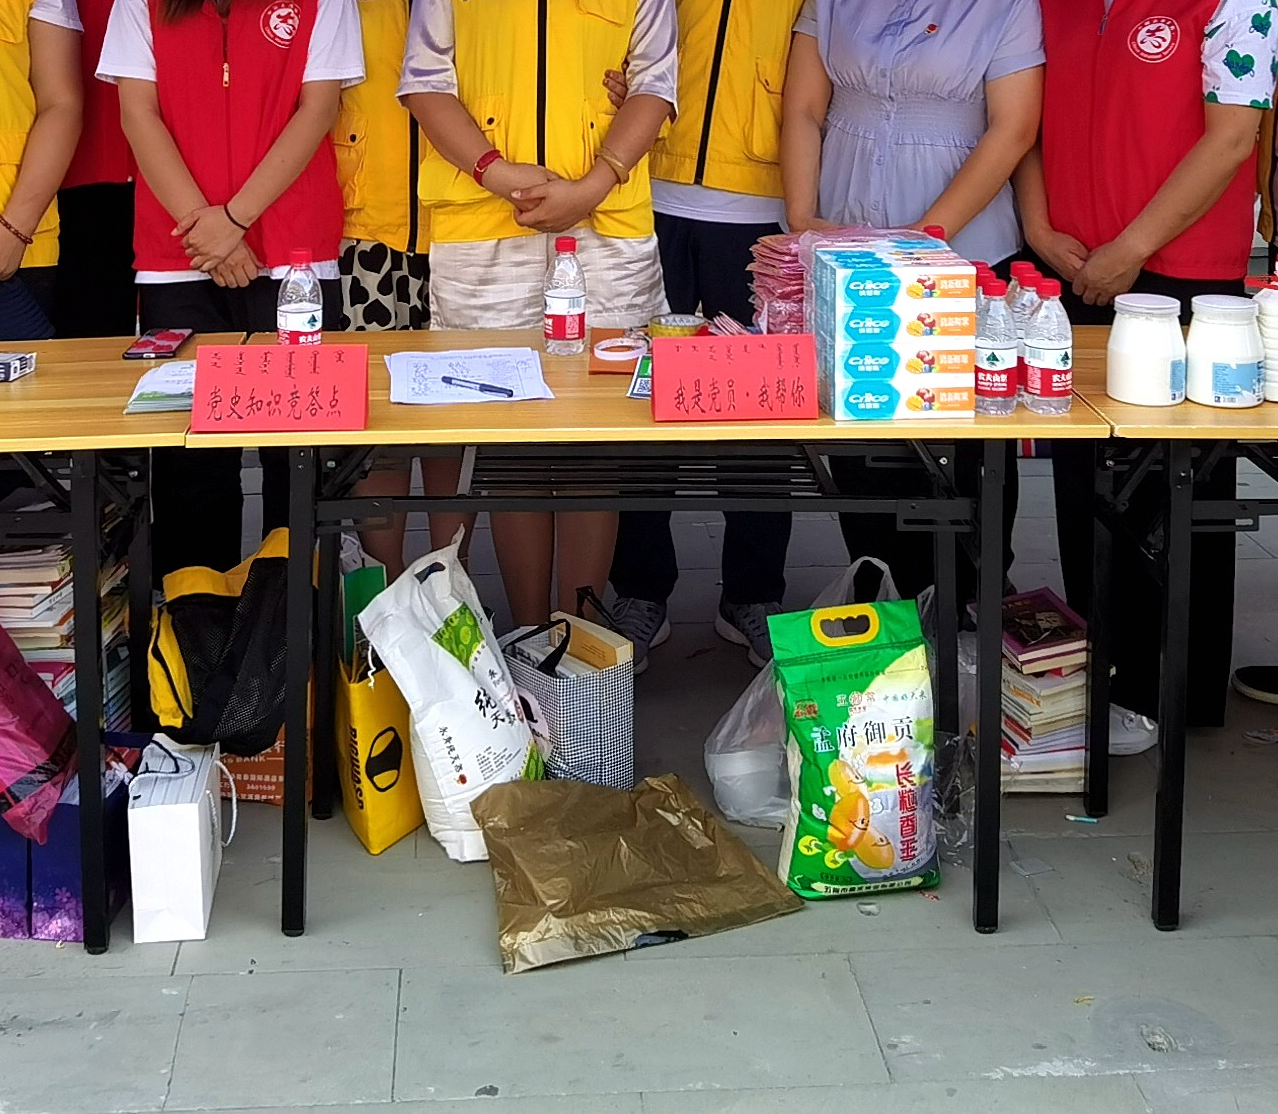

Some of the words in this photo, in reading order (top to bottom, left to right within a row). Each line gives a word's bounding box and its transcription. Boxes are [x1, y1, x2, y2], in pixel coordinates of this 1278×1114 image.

[206, 385, 342, 422] 党史知识竞答点
[810, 715, 915, 754] 孟府御贡
[895, 761, 919, 863] 长粒香米
